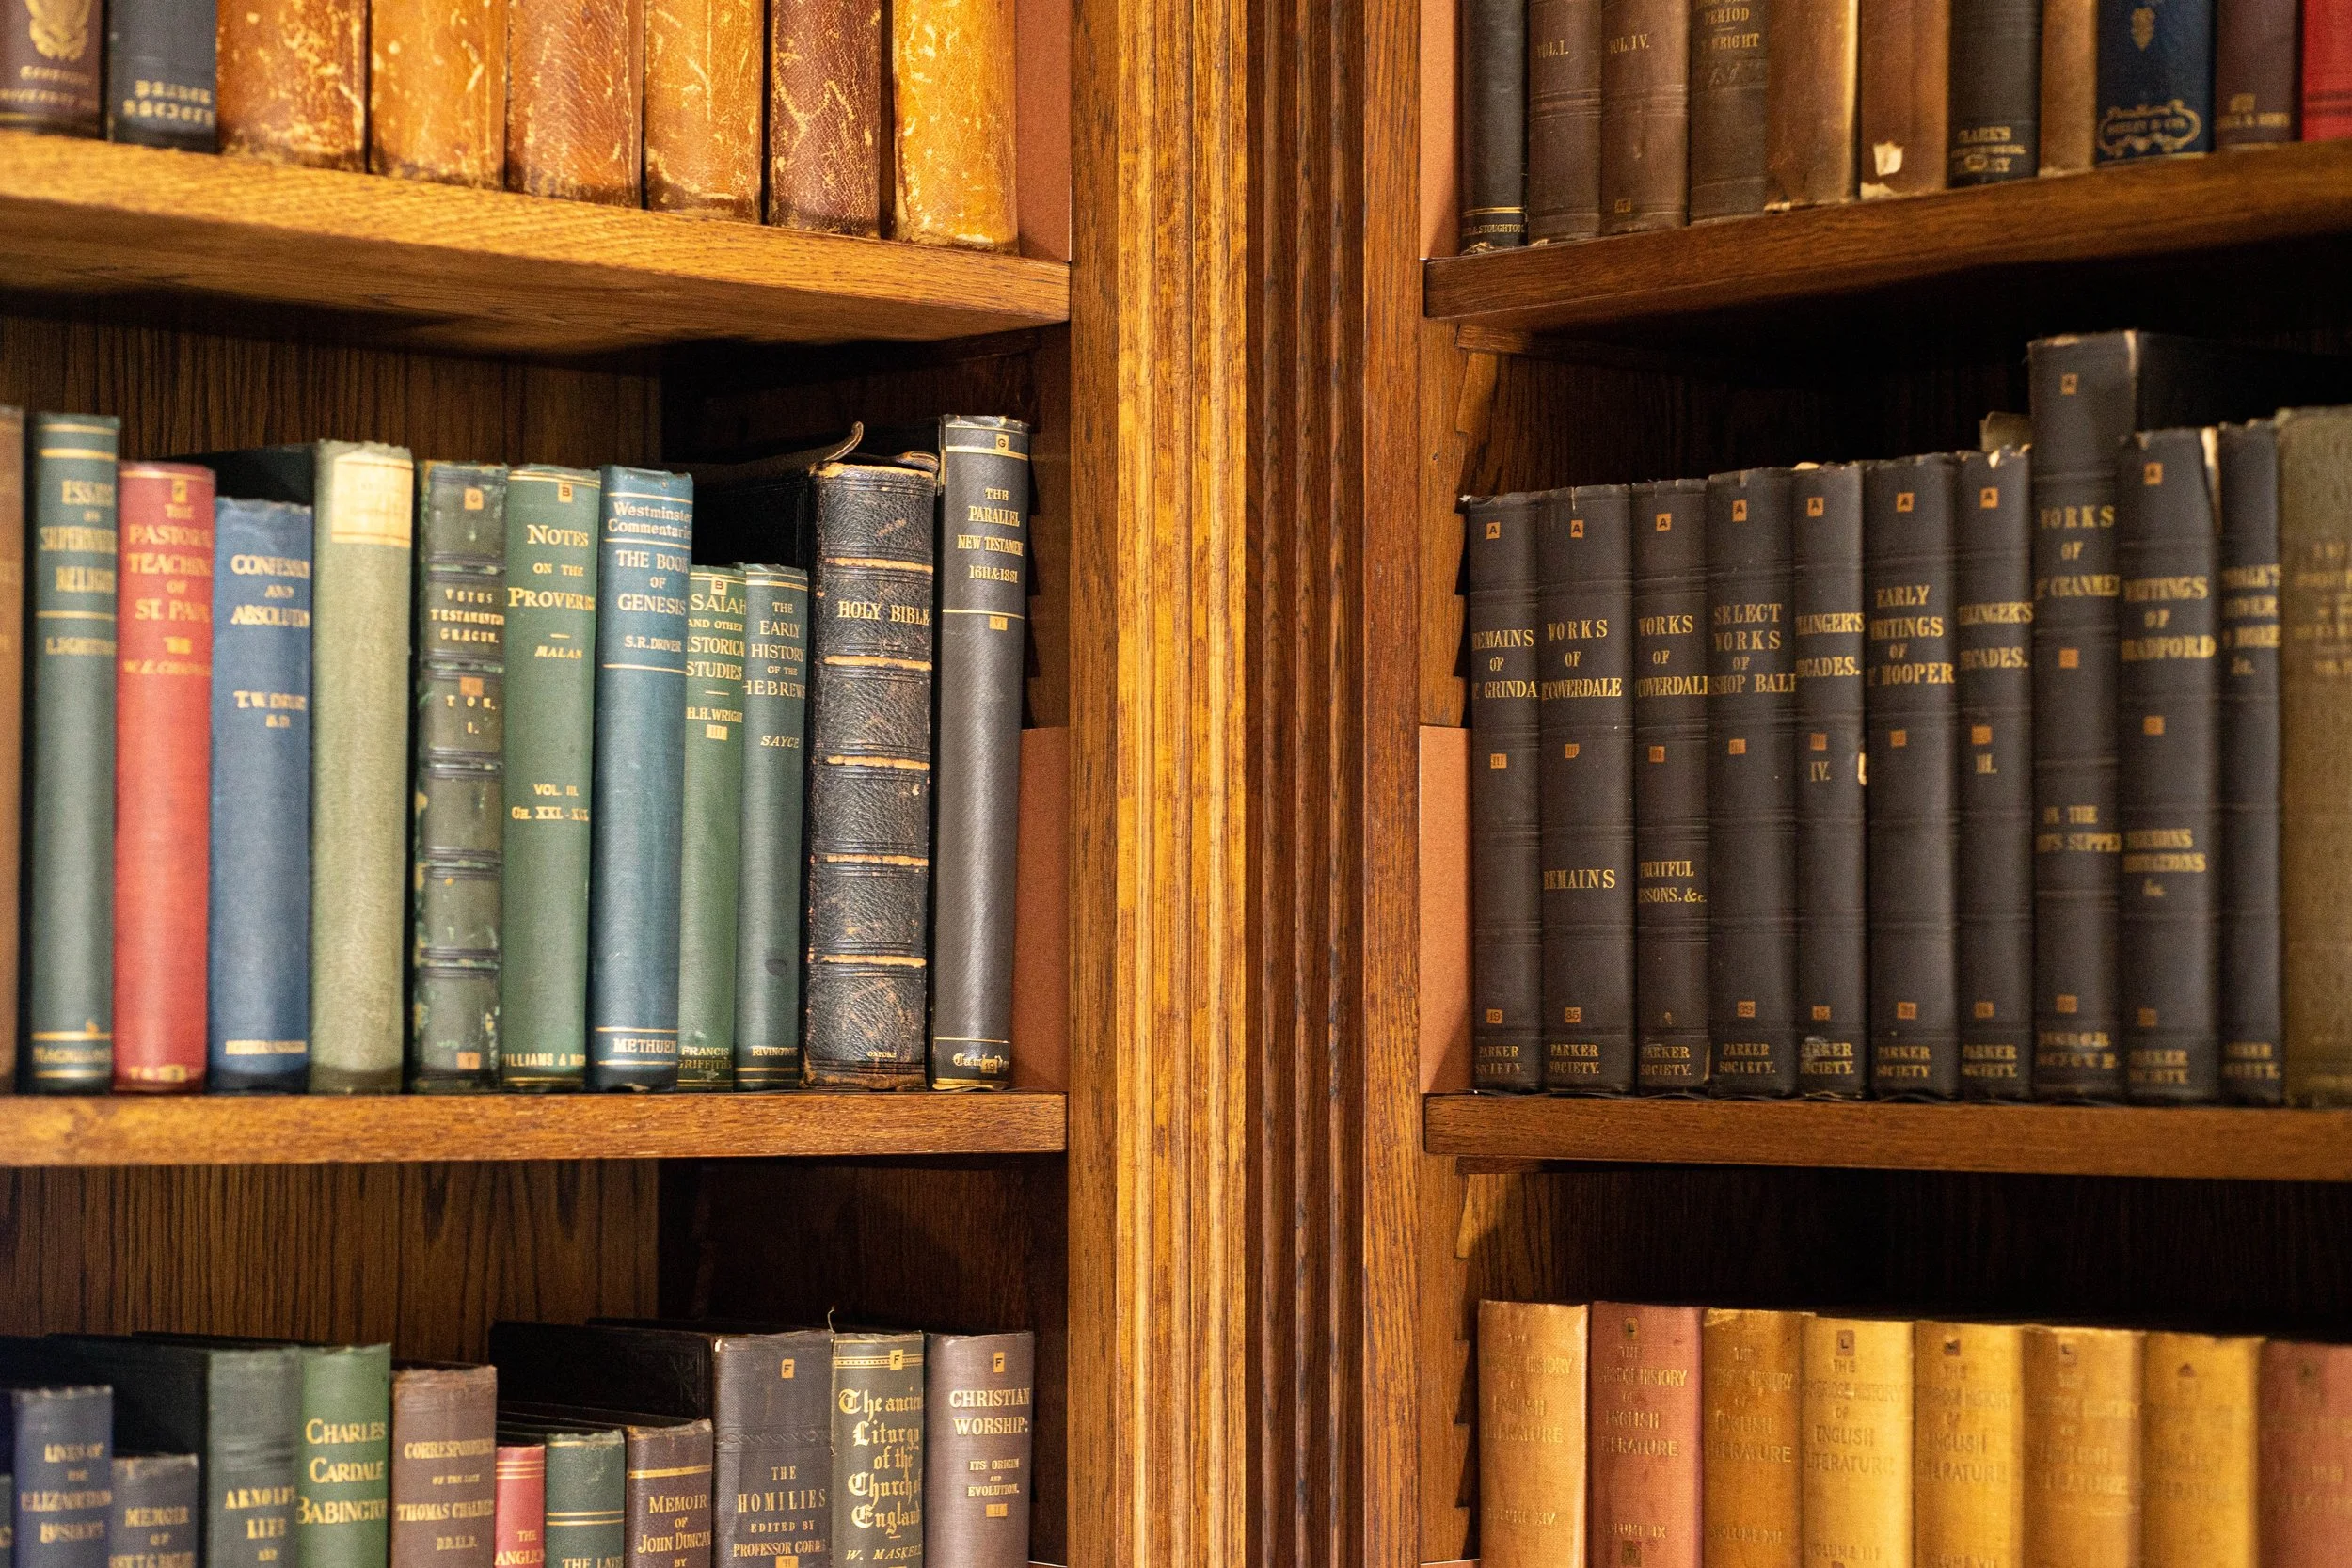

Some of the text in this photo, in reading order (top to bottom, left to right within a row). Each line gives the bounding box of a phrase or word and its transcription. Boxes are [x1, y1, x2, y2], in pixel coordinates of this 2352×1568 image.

[984, 487, 1009, 502] THE
[967, 505, 1021, 528] PARALLEL
[527, 524, 590, 546] NOTES
[957, 534, 982, 551] NEW
[616, 550, 649, 568] THE
[532, 562, 584, 578] ON THE
[650, 577, 667, 590] OF
[617, 594, 686, 616] GENESIS
[691, 593, 746, 615] SAIAH
[1876, 584, 1930, 609] EARLY
[772, 601, 794, 614] THE
[837, 600, 931, 626] HOLY BIBLE
[1714, 603, 1783, 626] SELECT
[760, 620, 801, 639] EARLY
[1548, 618, 1608, 641] WORKS
[1639, 614, 1694, 637] WORKS
[1472, 629, 1534, 651] REMAINS
[1714, 630, 1782, 652] WORKS
[751, 643, 805, 664] HISTORY
[1565, 651, 1581, 668] OF
[1652, 650, 1671, 665] OF
[767, 665, 799, 677] OF THE
[1489, 657, 1504, 672] OF
[1732, 656, 1751, 671] OF
[1485, 680, 1537, 698] GRINDA
[760, 735, 800, 750] SAYCE
[1543, 868, 1616, 891] REMAINS
[681, 1045, 730, 1057] FRANCIS
[1478, 1045, 1519, 1058] PARKER
[1550, 1044, 1599, 1057] PARKER
[1723, 1042, 1771, 1057] PARKER
[838, 1388, 883, 1422] The
[949, 1387, 1031, 1409] CHRISTIAN
[305, 1418, 386, 1445] CHARLES
[953, 1416, 1029, 1435] WORSHIP:
[1815, 1424, 1875, 1447] ENGLISH
[873, 1445, 893, 1470] of
[969, 1458, 1020, 1471] ITS ORIGIN
[309, 1457, 385, 1484] CARDALE
[771, 1465, 797, 1481] THE
[848, 1471, 913, 1507] Church
[967, 1483, 1020, 1497] EVOLUTION.
[649, 1494, 707, 1514] MEMOIR
[737, 1488, 826, 1513] HOMILIES
[396, 1503, 449, 1522] THOMAS
[851, 1500, 921, 1535] England
[675, 1517, 689, 1528] OF
[751, 1520, 816, 1533] EDITED BY
[638, 1534, 674, 1554] JOHN
[733, 1542, 791, 1557] PROFESSOR
[674, 1558, 688, 1568] BY
[847, 1549, 864, 1560] W.
